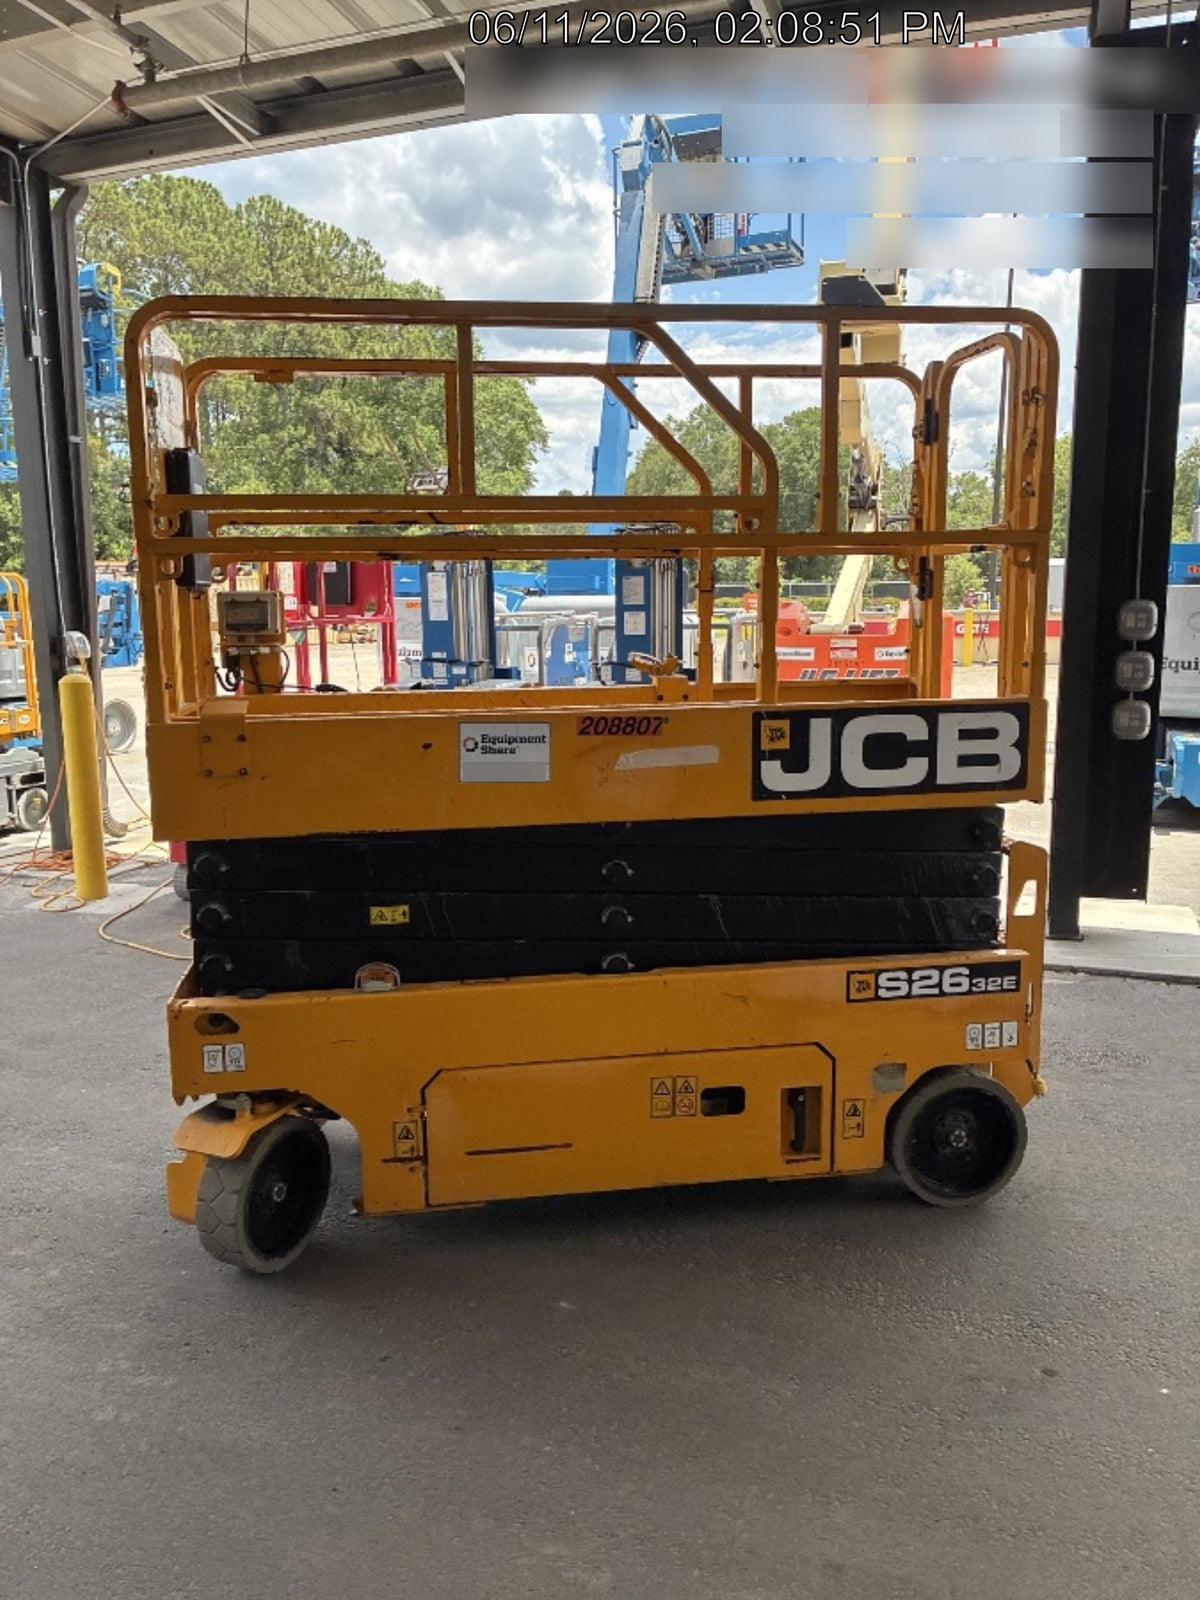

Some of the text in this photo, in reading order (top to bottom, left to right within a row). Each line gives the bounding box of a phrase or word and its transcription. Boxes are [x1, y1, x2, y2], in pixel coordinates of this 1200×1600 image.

[577, 716, 663, 735] 208807
[480, 734, 547, 745] Equipment
[480, 745, 516, 755] Share
[760, 711, 1021, 792] JCB
[877, 967, 970, 998] S26
[971, 975, 1017, 992] 32E
